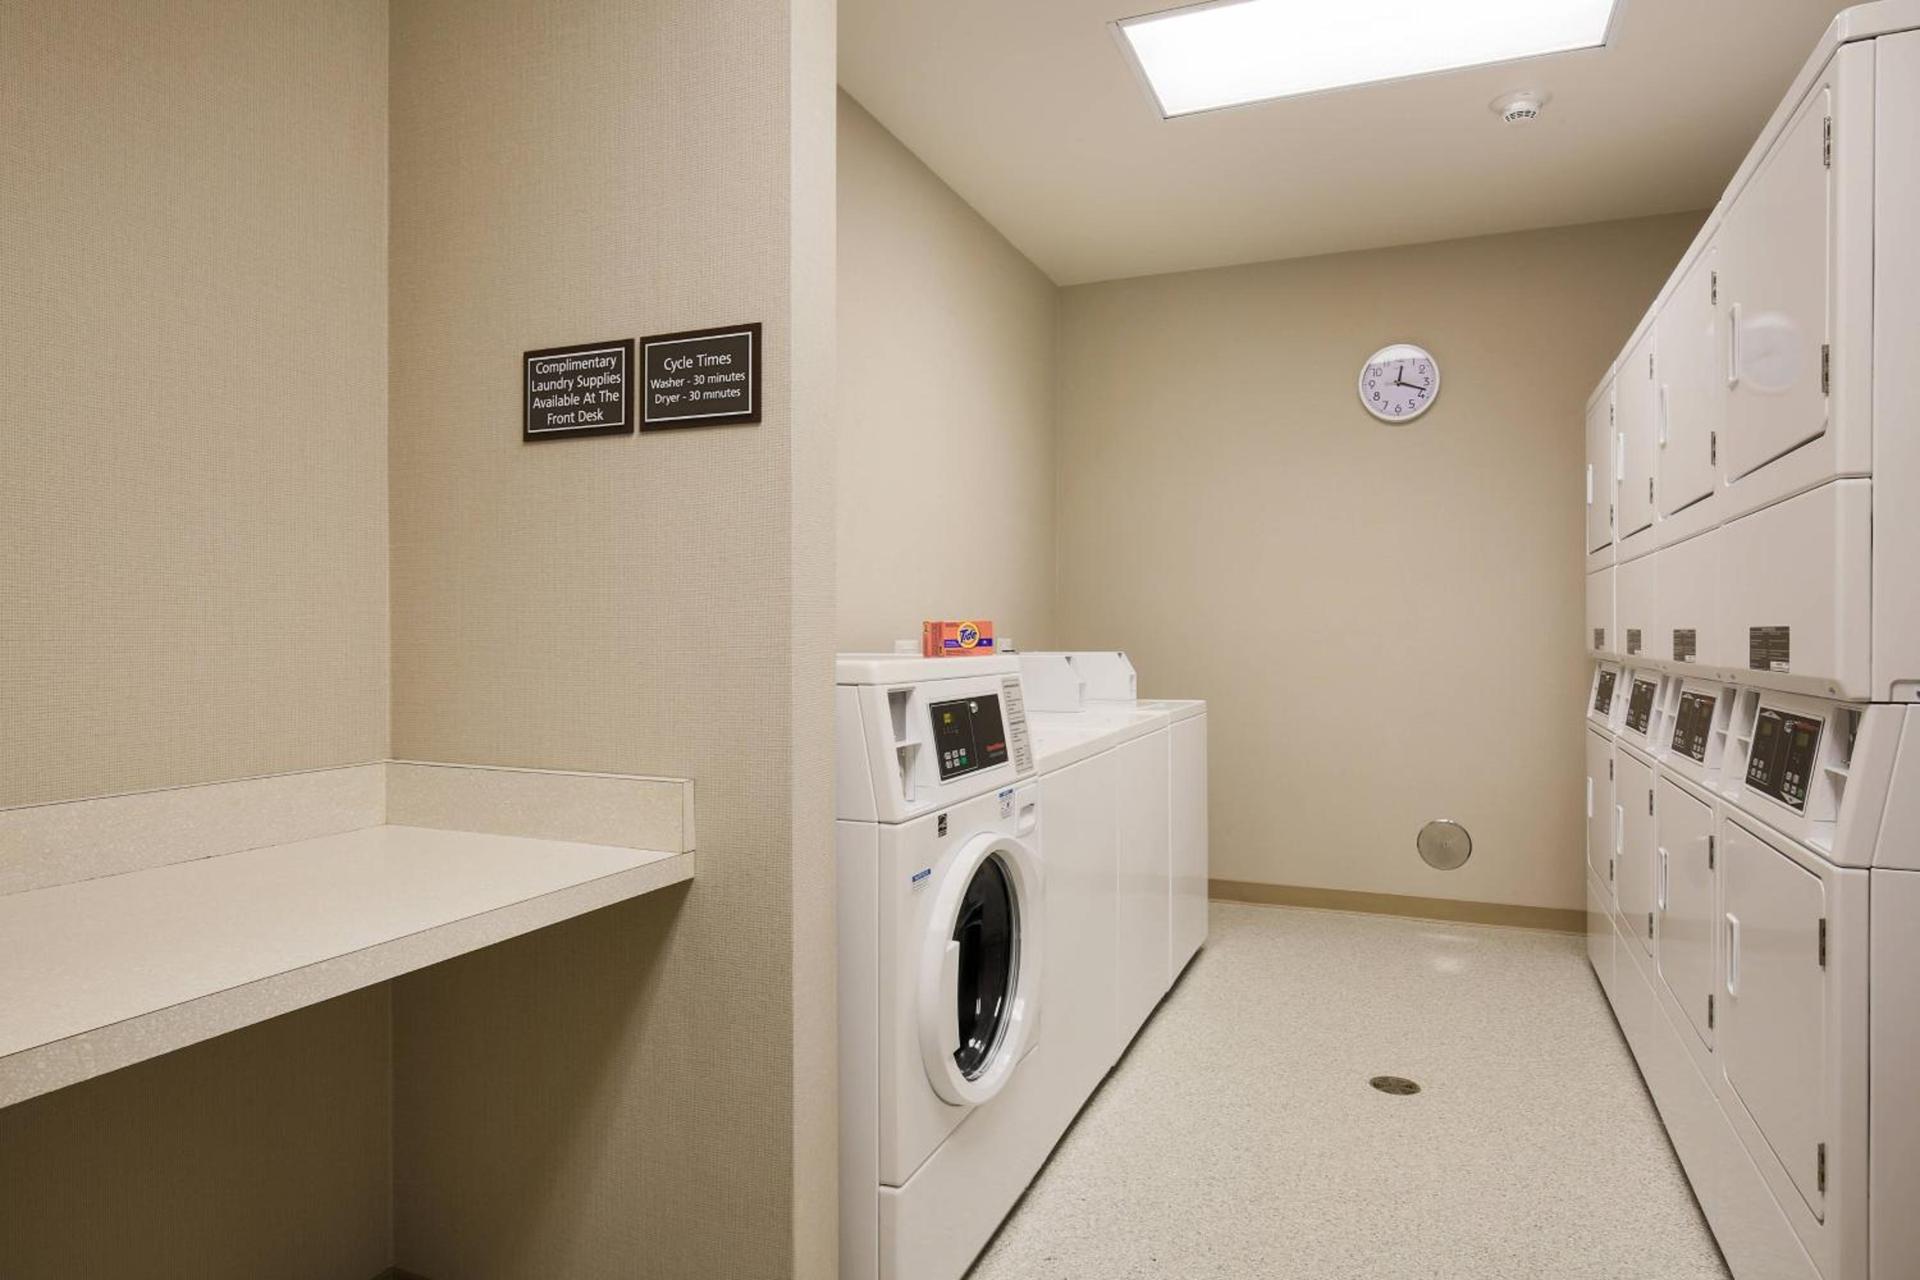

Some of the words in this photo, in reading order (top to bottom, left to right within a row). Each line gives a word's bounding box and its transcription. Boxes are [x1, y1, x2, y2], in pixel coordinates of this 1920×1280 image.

[535, 356, 617, 374] Complimentary
[663, 355, 694, 373] Cycle
[696, 353, 732, 367] Times
[1418, 364, 1426, 374] 2
[1369, 367, 1383, 377] 10
[531, 377, 574, 392] Laundry
[576, 372, 621, 389] Supplies
[650, 377, 685, 390] Washer
[693, 374, 705, 386] 30
[707, 371, 746, 384] minutes
[1368, 379, 1376, 390] 9
[532, 393, 580, 409] Available
[583, 392, 596, 404] At
[598, 389, 620, 402] The
[654, 393, 680, 406] Dryer
[689, 390, 701, 402] 30
[703, 388, 741, 400] minutes
[1372, 391, 1381, 401] 8
[1408, 398, 1416, 409] 5
[1382, 400, 1389, 410] 7
[1394, 404, 1402, 413] 6
[547, 412, 575, 425] Front
[578, 408, 604, 422] Desk
[959, 628, 978, 643] Tide
